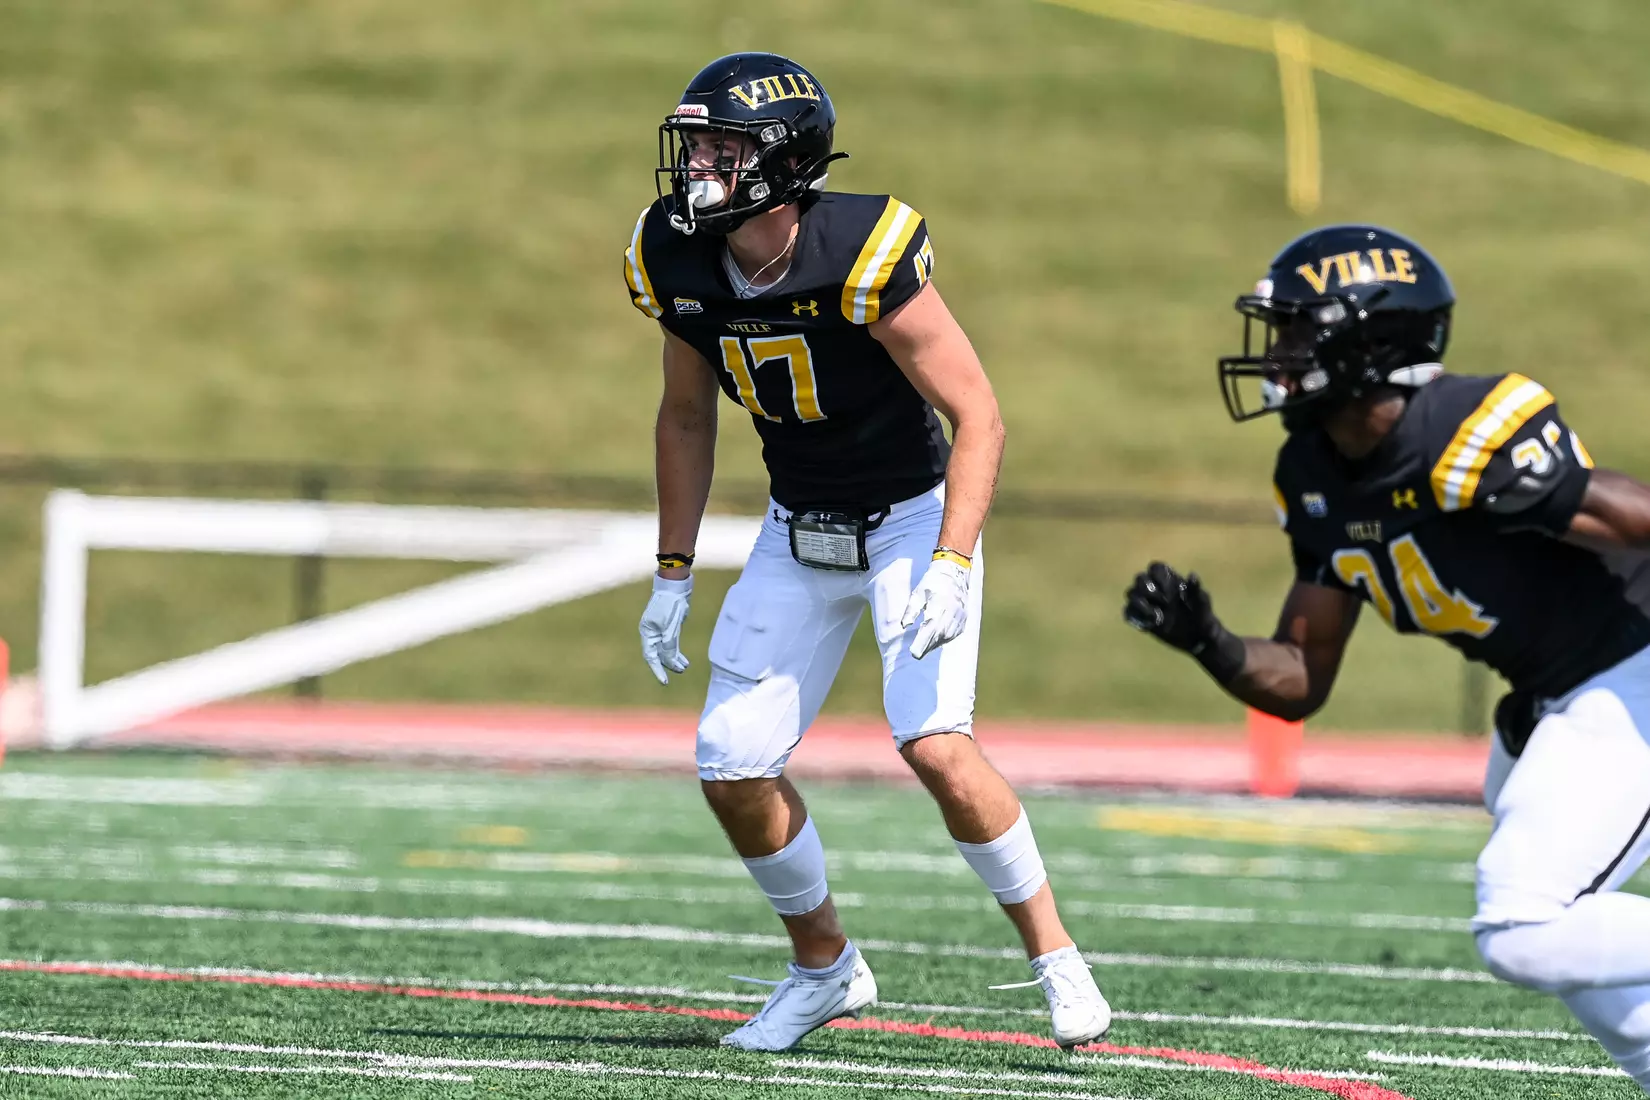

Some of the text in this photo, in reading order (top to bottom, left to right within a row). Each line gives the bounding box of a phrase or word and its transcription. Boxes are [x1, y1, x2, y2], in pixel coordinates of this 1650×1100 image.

[728, 74, 820, 110] VILLE
[1296, 248, 1417, 294] VILLE
[676, 302, 700, 311] PSAC
[719, 333, 828, 423] 17
[1331, 533, 1499, 639] 24
